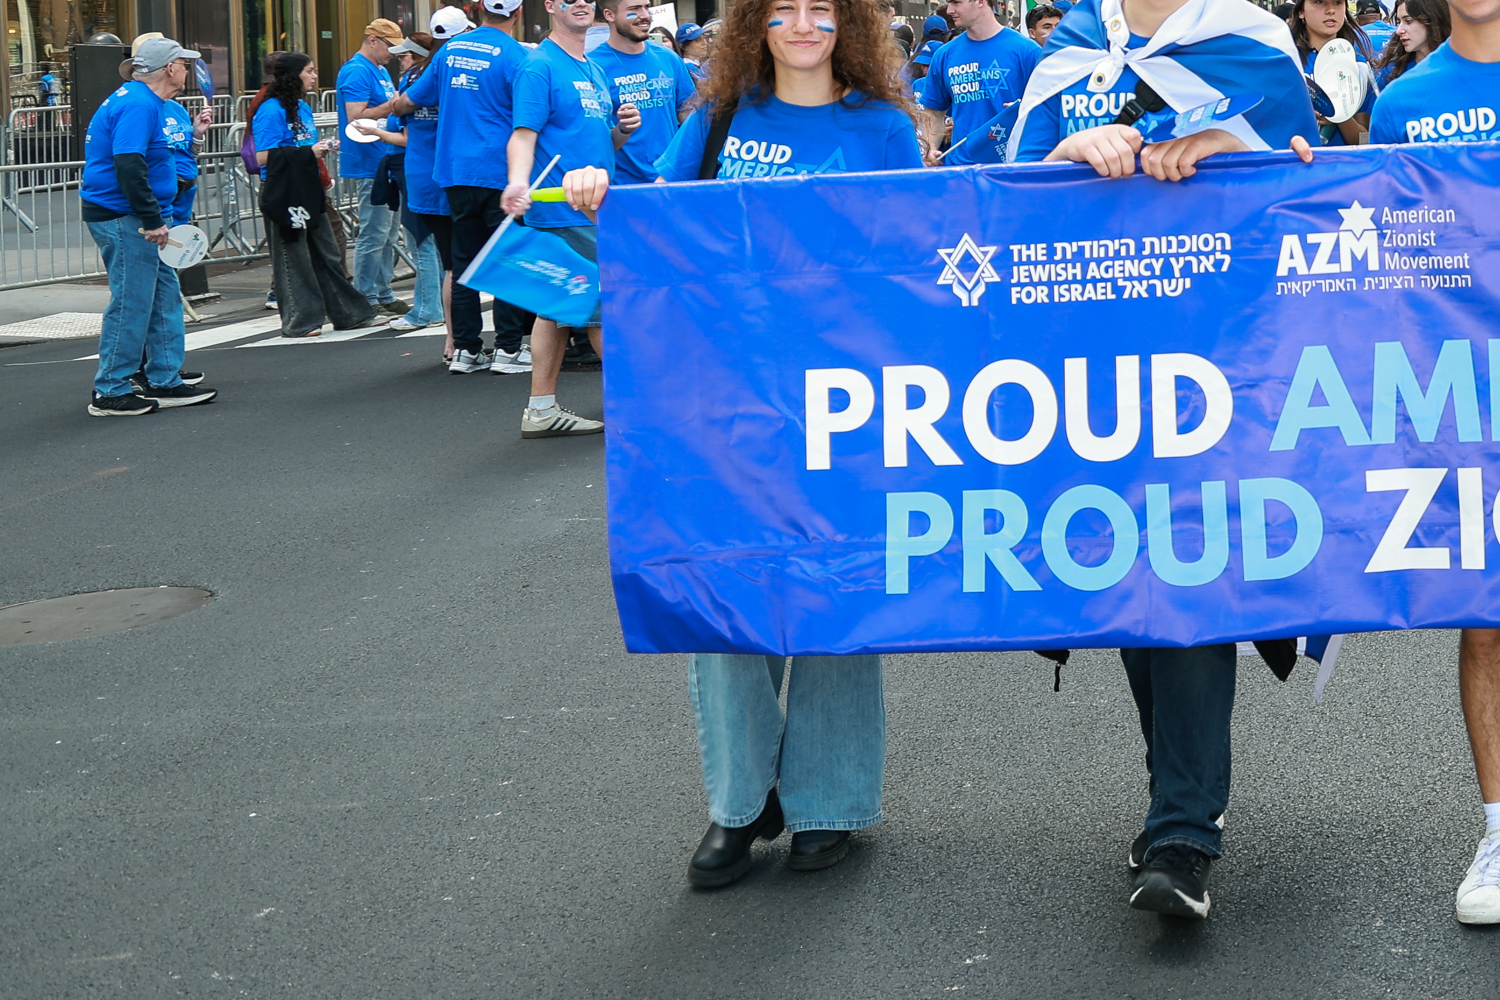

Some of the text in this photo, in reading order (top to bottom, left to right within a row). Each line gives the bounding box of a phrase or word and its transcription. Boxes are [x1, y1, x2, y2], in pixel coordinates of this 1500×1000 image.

[613, 73, 647, 86] PROUD
[948, 62, 979, 77] PROUD
[619, 90, 651, 104] PROUD
[1061, 92, 1136, 118] PROU
[1406, 107, 1497, 143] PROUD
[724, 136, 792, 164] ROUD
[1381, 206, 1456, 224] American
[1054, 232, 1232, 260] הסוכנות היהודית
[1382, 229, 1436, 248] Zionist
[1008, 243, 1048, 262] THE
[1275, 230, 1380, 276] AZM
[1384, 252, 1470, 270] Movement
[1010, 258, 1164, 284] JEWISH AGENCY
[1168, 252, 1232, 278] לארץ
[1010, 282, 1116, 305] FOR ISRAEL
[1118, 277, 1191, 300] ישראל
[1276, 274, 1472, 298] התנועה הציונית האמריקאית
[804, 351, 1233, 471] PROUD
[885, 476, 1324, 596] PROUD
